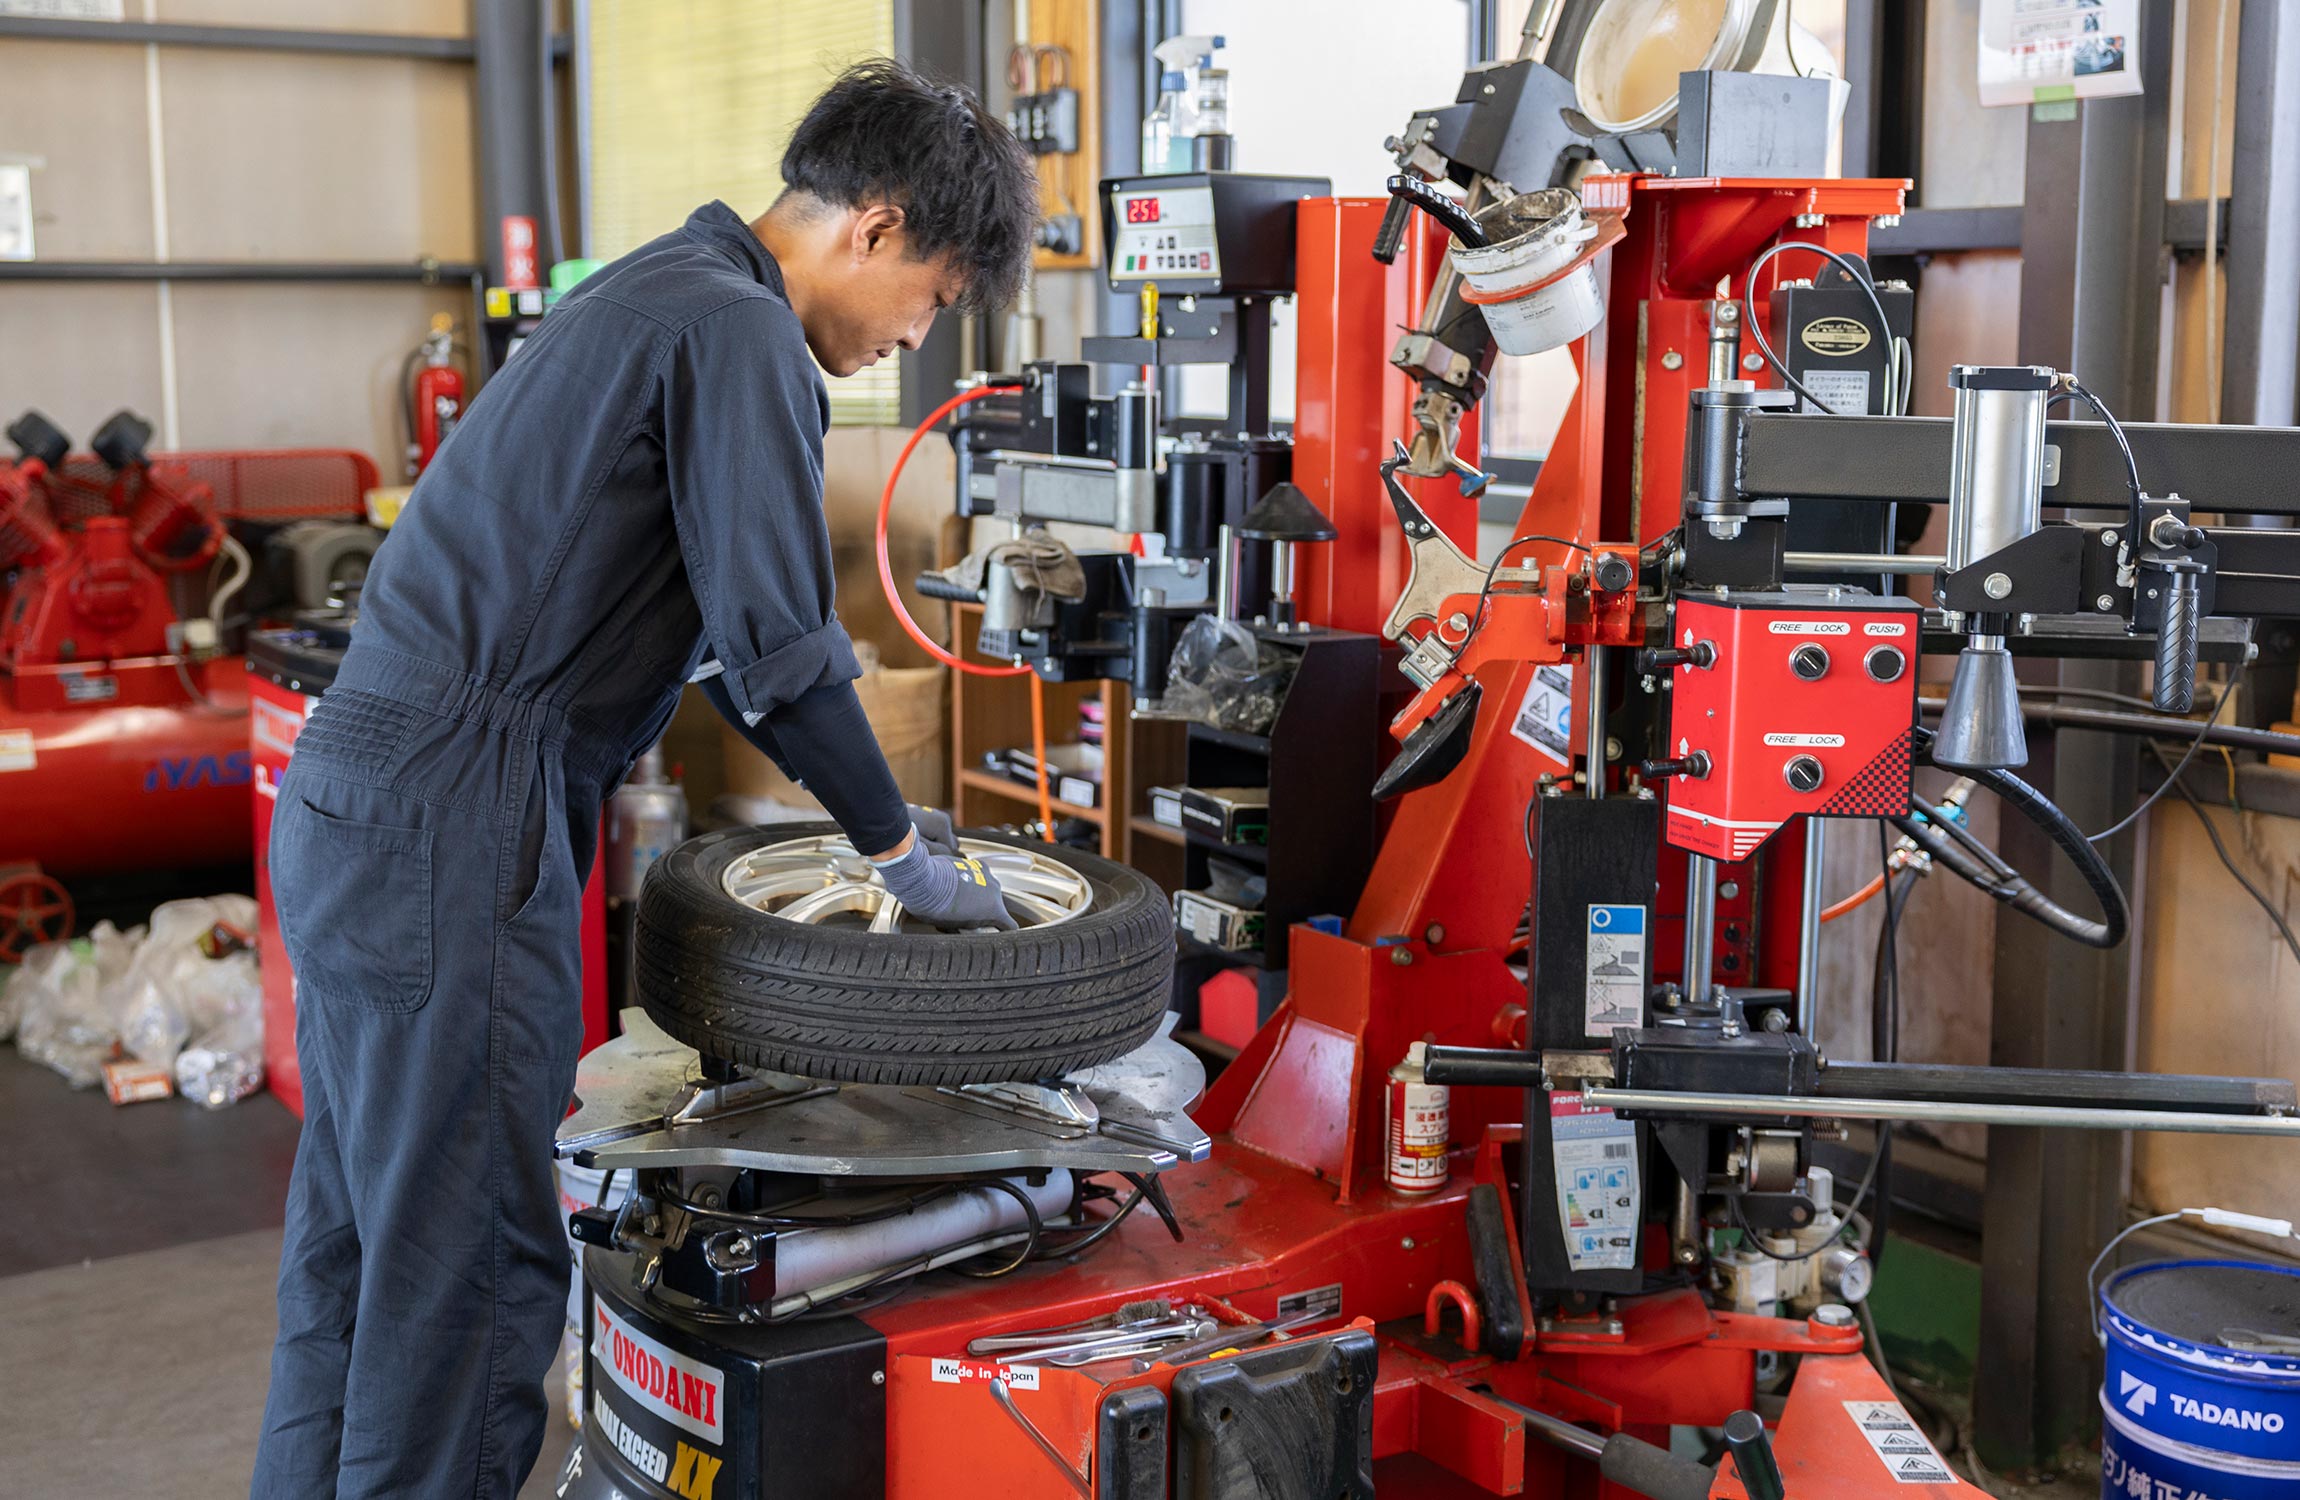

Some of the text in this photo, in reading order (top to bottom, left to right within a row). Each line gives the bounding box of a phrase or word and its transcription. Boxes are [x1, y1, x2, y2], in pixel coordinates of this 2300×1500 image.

[1772, 623, 1845, 632] FREE LOCK
[1868, 625, 1900, 633] PUSH
[1767, 735, 1839, 745] FREE LOCK
[613, 1328, 717, 1428] ONODANI
[939, 1365, 1034, 1382] Made in Japan
[2169, 1393, 2285, 1434] TADANO
[617, 1421, 669, 1484] EXCEED
[666, 1440, 723, 1500] XX
